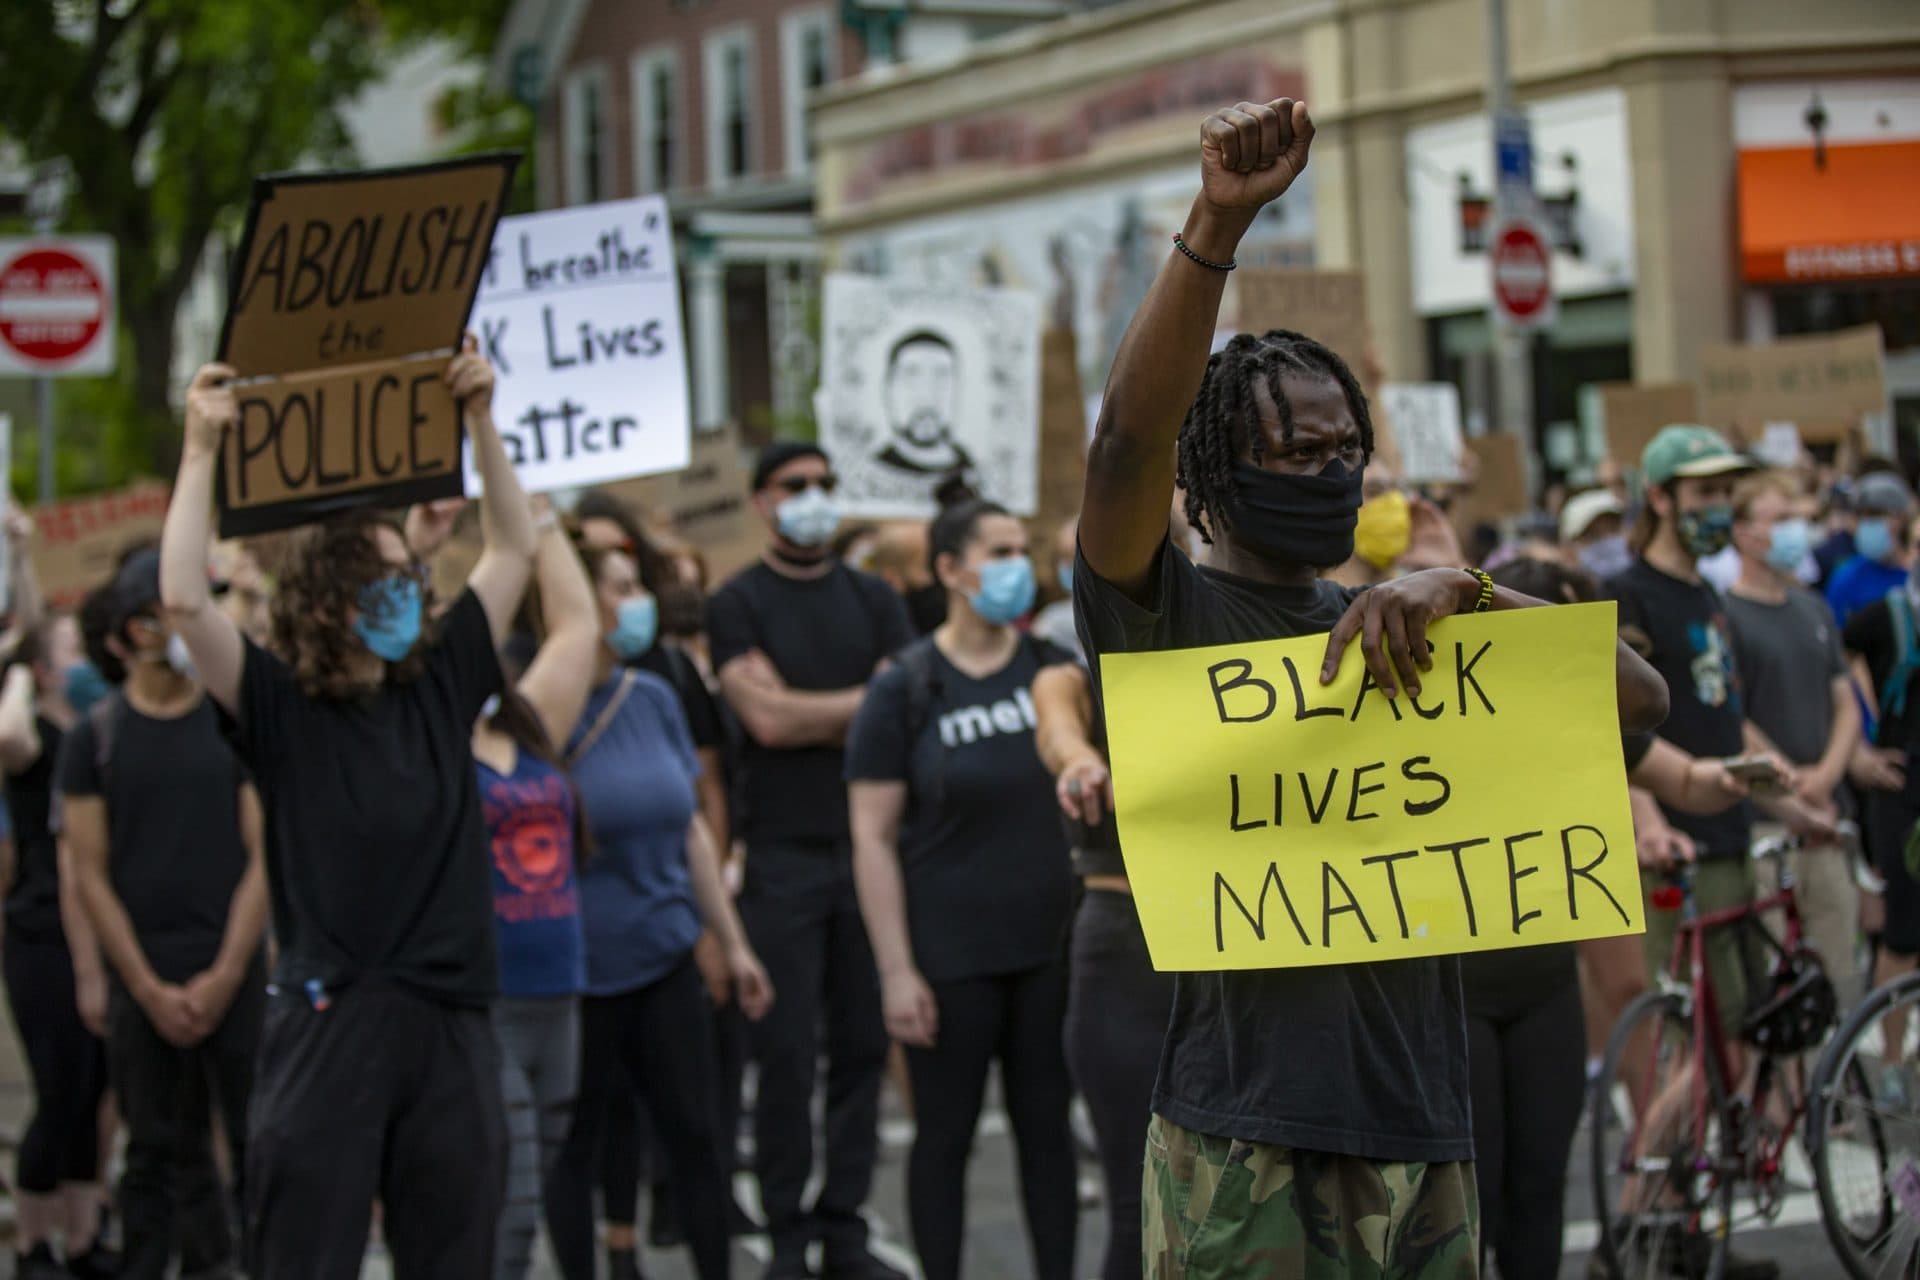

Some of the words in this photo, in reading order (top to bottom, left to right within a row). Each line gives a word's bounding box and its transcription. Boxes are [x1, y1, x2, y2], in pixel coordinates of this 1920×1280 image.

[238, 201, 488, 313] ABOLISH
[317, 320, 386, 360] the
[542, 304, 665, 371] Lives
[236, 373, 446, 500] POLICE
[500, 397, 639, 467] atter
[1207, 640, 1497, 724] BLACK
[1229, 755, 1451, 832] LIVES
[1213, 824, 1631, 953] MATTER
